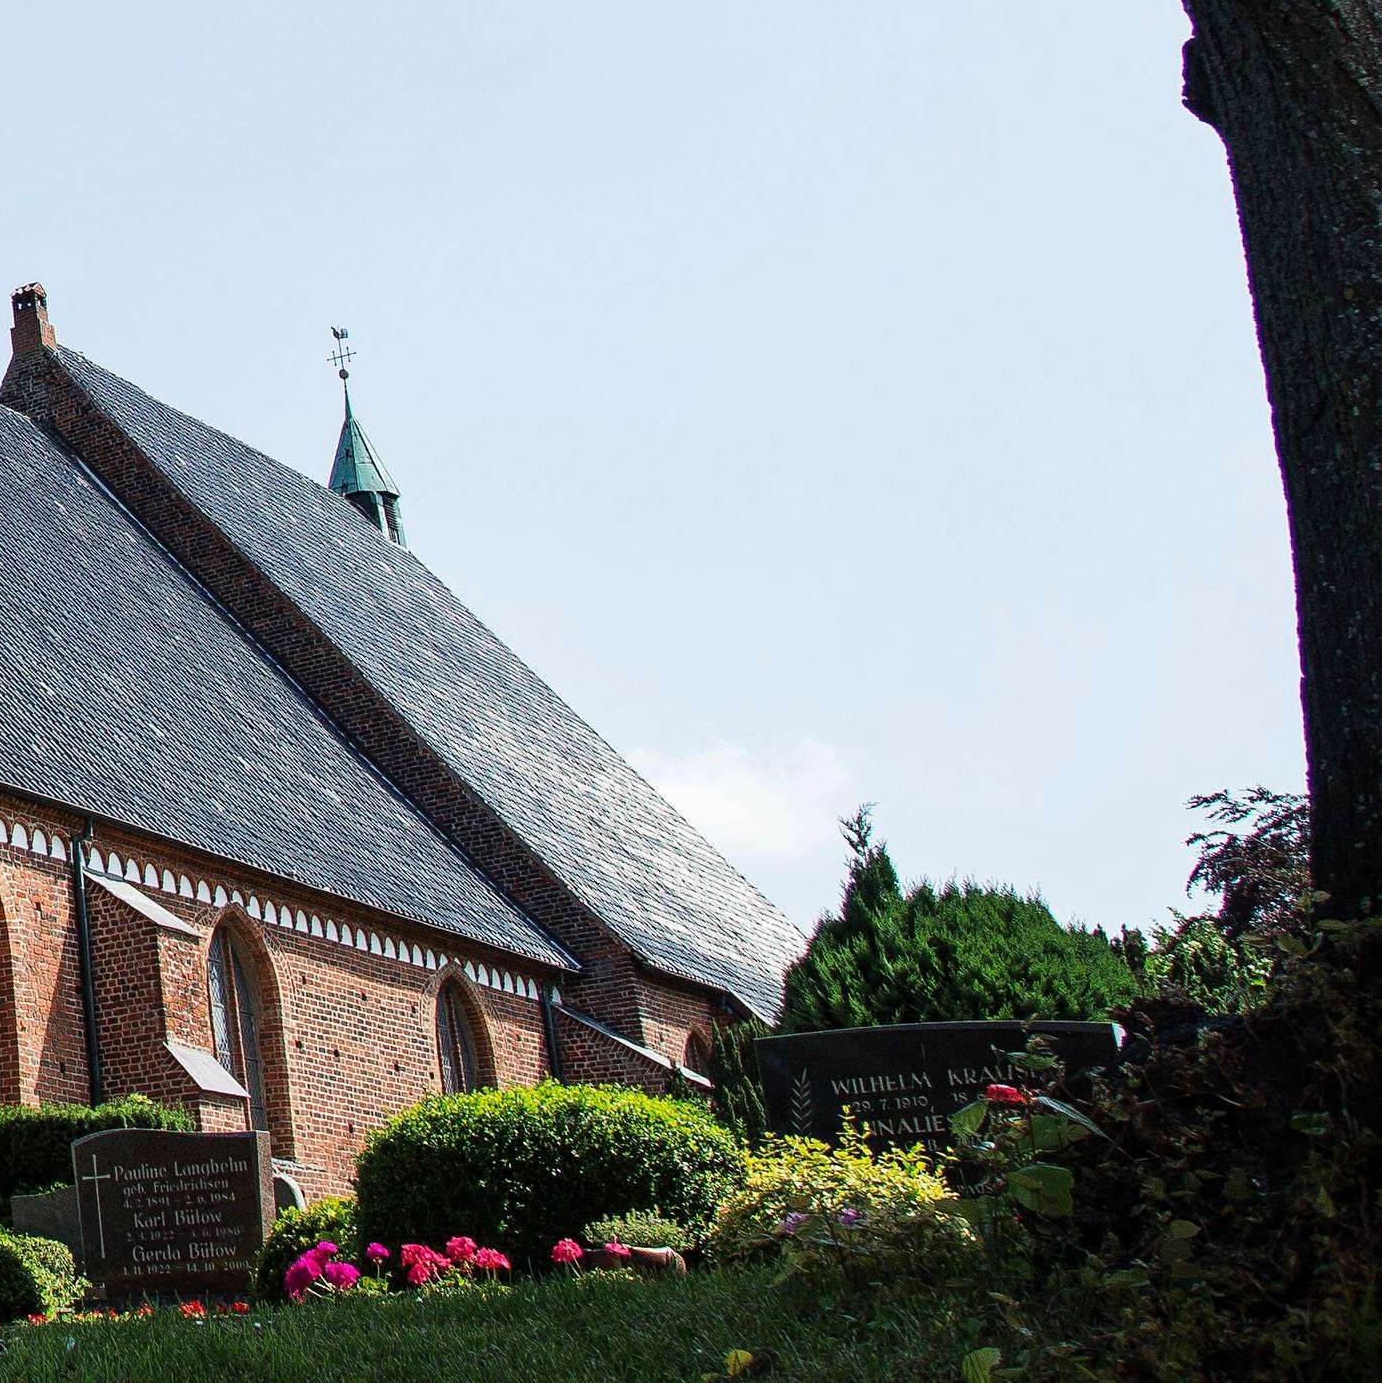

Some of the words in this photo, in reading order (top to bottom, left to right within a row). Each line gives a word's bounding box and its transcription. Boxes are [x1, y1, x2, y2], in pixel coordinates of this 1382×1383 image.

[831, 1072, 933, 1095] WILHELM
[947, 1064, 1038, 1086] KRAUS
[894, 1095, 928, 1110] 1910
[114, 1162, 167, 1182] Pauline
[174, 1156, 248, 1177] Langbehn
[123, 1182, 146, 1197] geb.
[211, 1191, 236, 1202] 1984
[133, 1210, 166, 1228] Karl
[175, 1208, 223, 1226] Bülow
[132, 1244, 181, 1262] Gerda
[189, 1241, 237, 1259] Bülow
[147, 1263, 172, 1274] 1922
